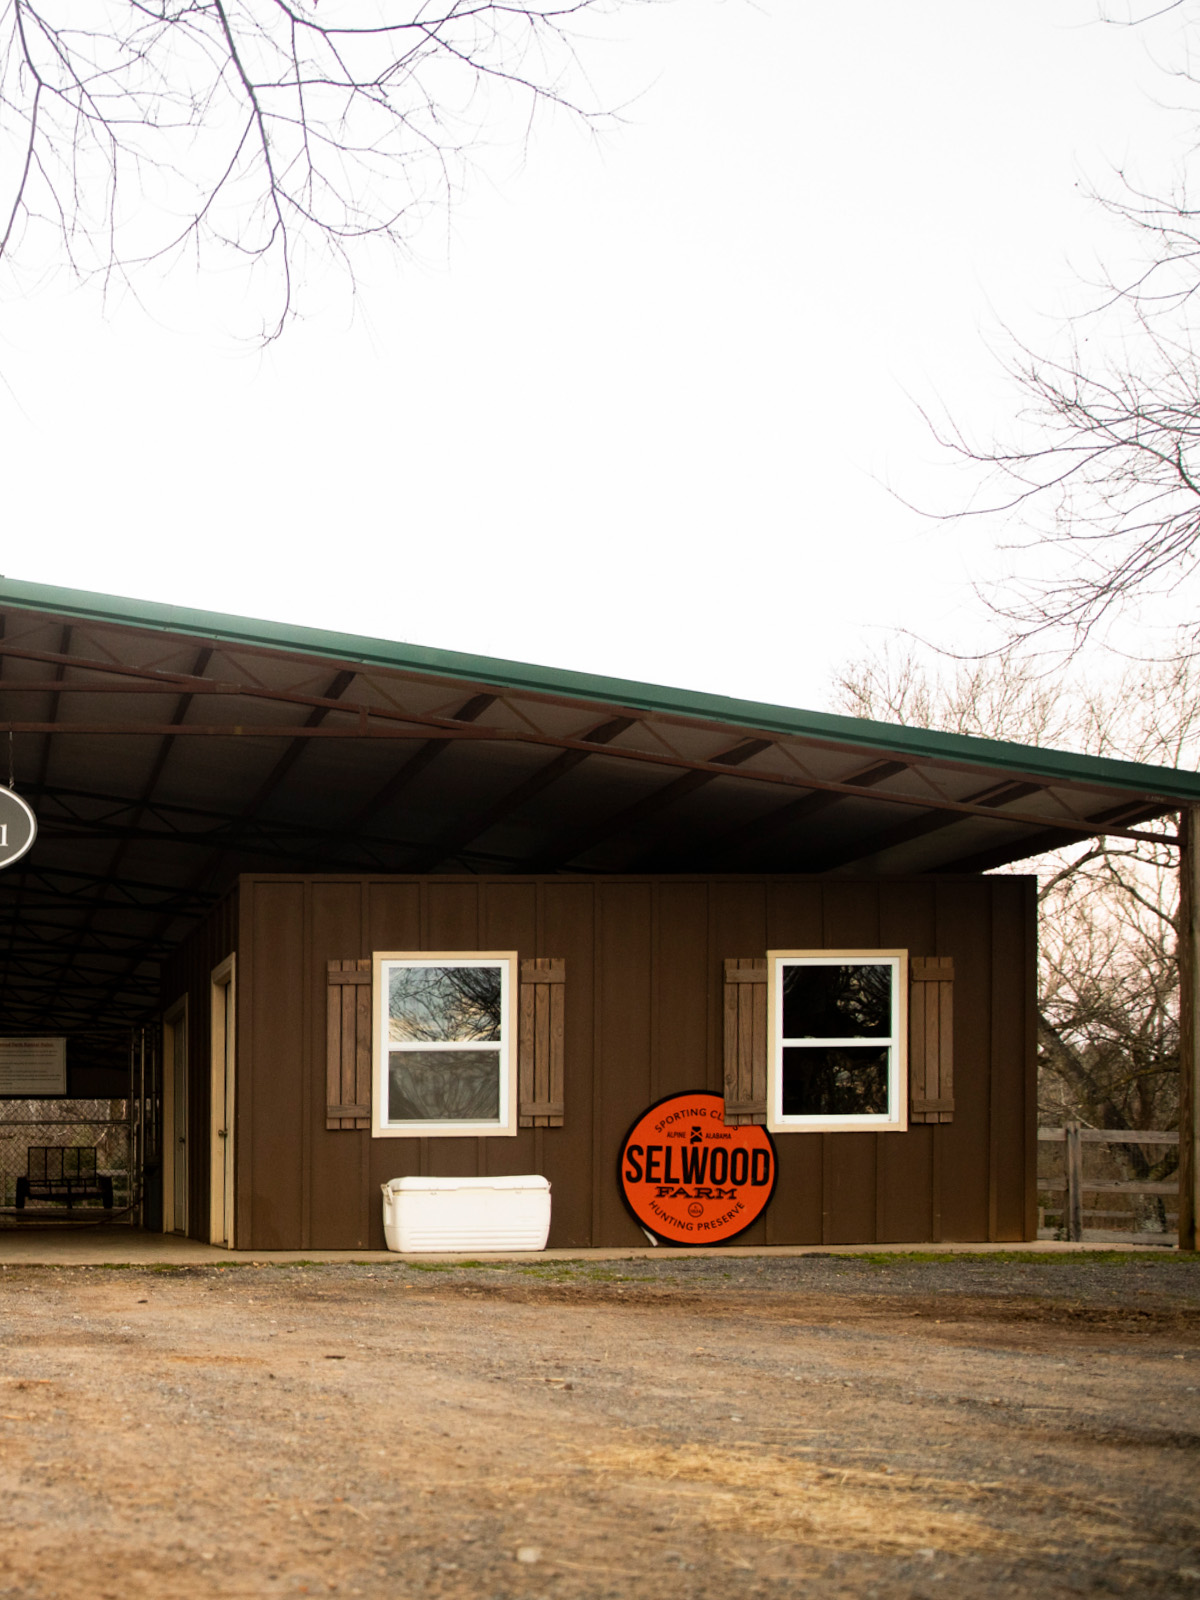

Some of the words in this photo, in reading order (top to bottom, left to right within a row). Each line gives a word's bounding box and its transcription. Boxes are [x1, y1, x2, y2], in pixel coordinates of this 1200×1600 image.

[654, 1108, 707, 1134] SPORTING
[667, 1131, 686, 1139] ALPINE
[705, 1132, 732, 1140] ALABAMA
[625, 1144, 770, 1187] SELWOOD
[654, 1186, 738, 1200] FARM
[648, 1200, 694, 1231] HUNTING
[697, 1201, 745, 1231] PRESERVE
